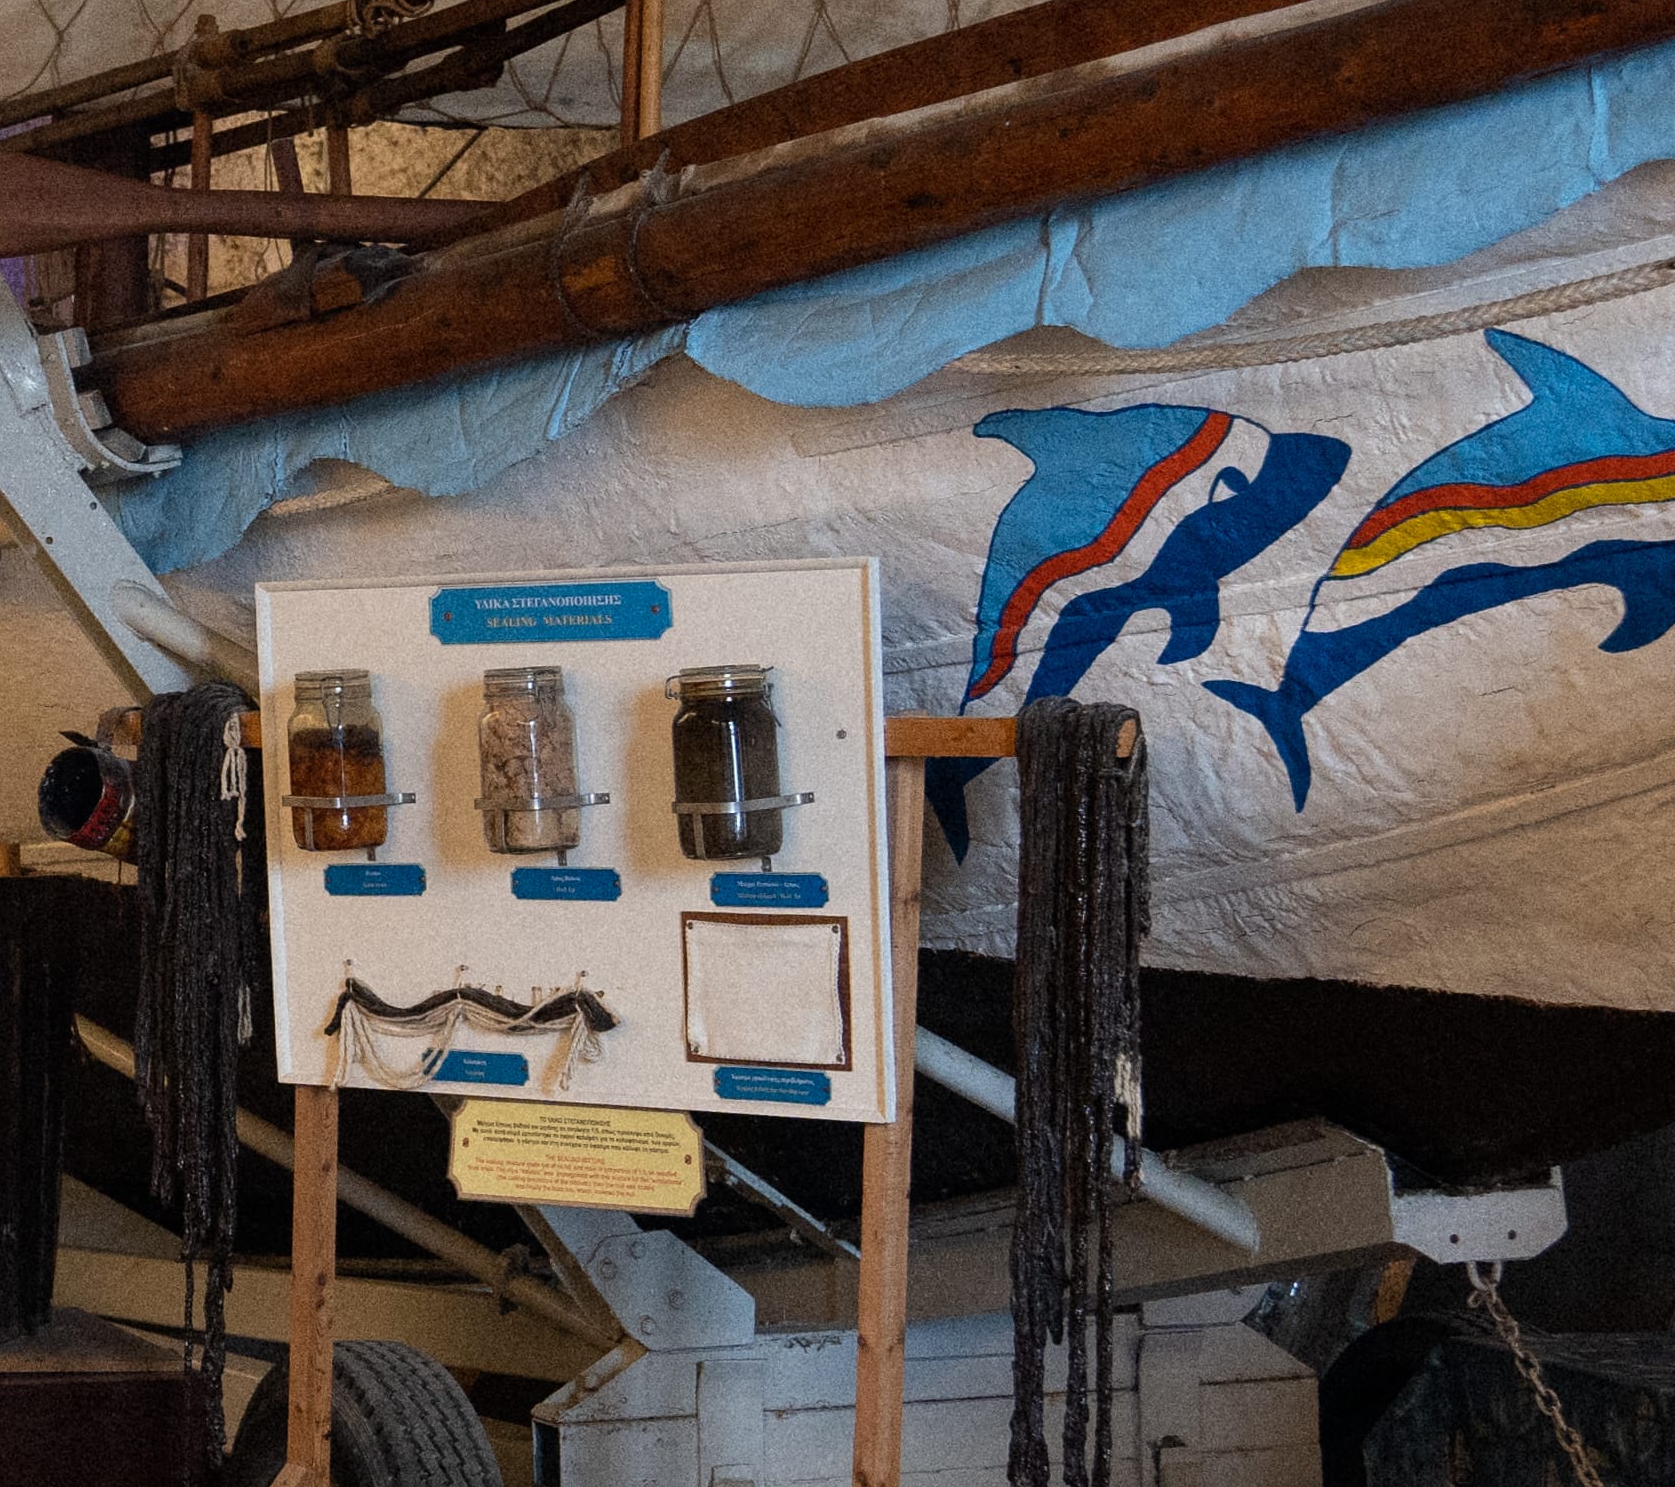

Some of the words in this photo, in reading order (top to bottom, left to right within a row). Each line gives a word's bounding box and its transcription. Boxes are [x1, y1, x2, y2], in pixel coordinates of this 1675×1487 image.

[474, 598, 510, 609] ΥΛΙΚΑ
[486, 617, 537, 628] SEALING
[542, 614, 613, 626] MATERIALS
